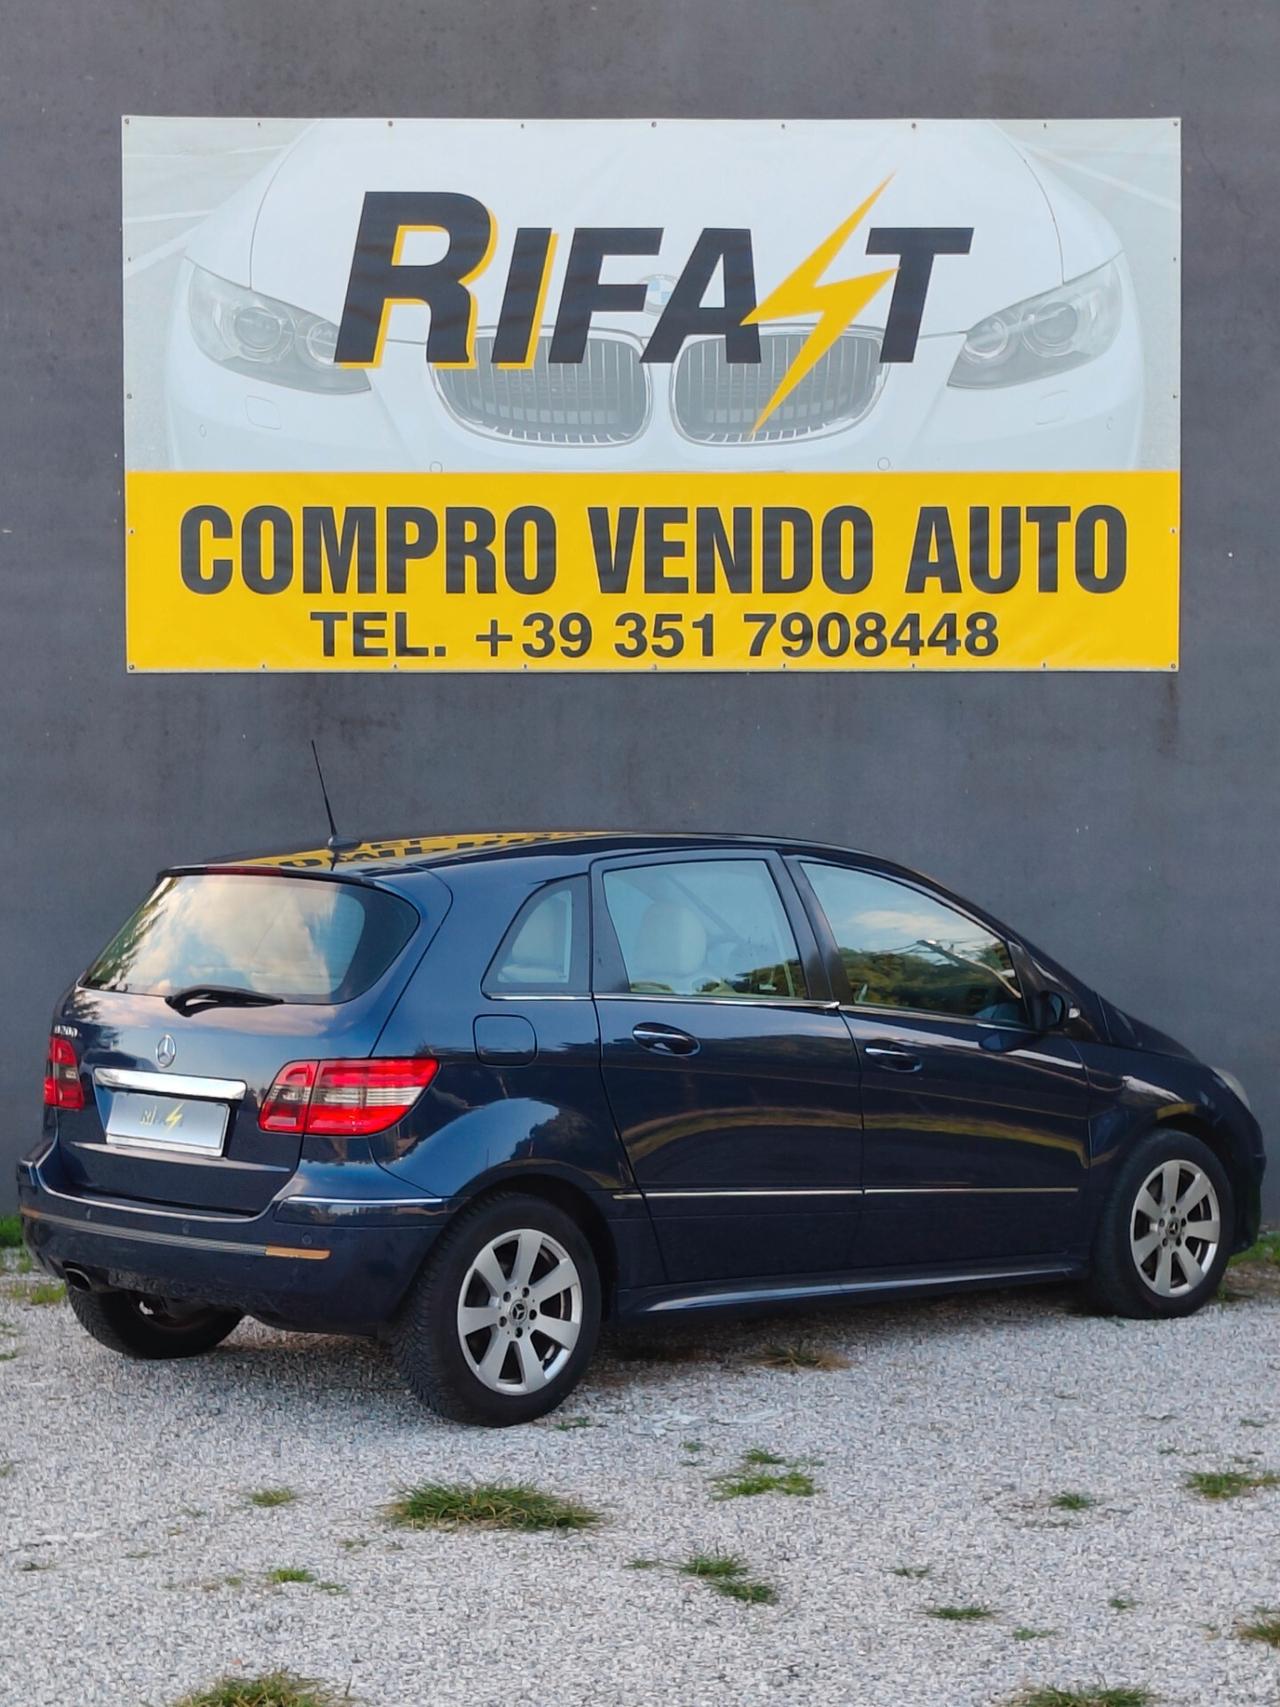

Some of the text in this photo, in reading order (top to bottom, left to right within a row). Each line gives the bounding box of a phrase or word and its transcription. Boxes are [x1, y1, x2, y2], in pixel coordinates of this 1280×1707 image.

[180, 504, 1127, 595] COMPRO VENDO AUTO
[310, 611, 999, 658] TEL. +39 351 7908448
